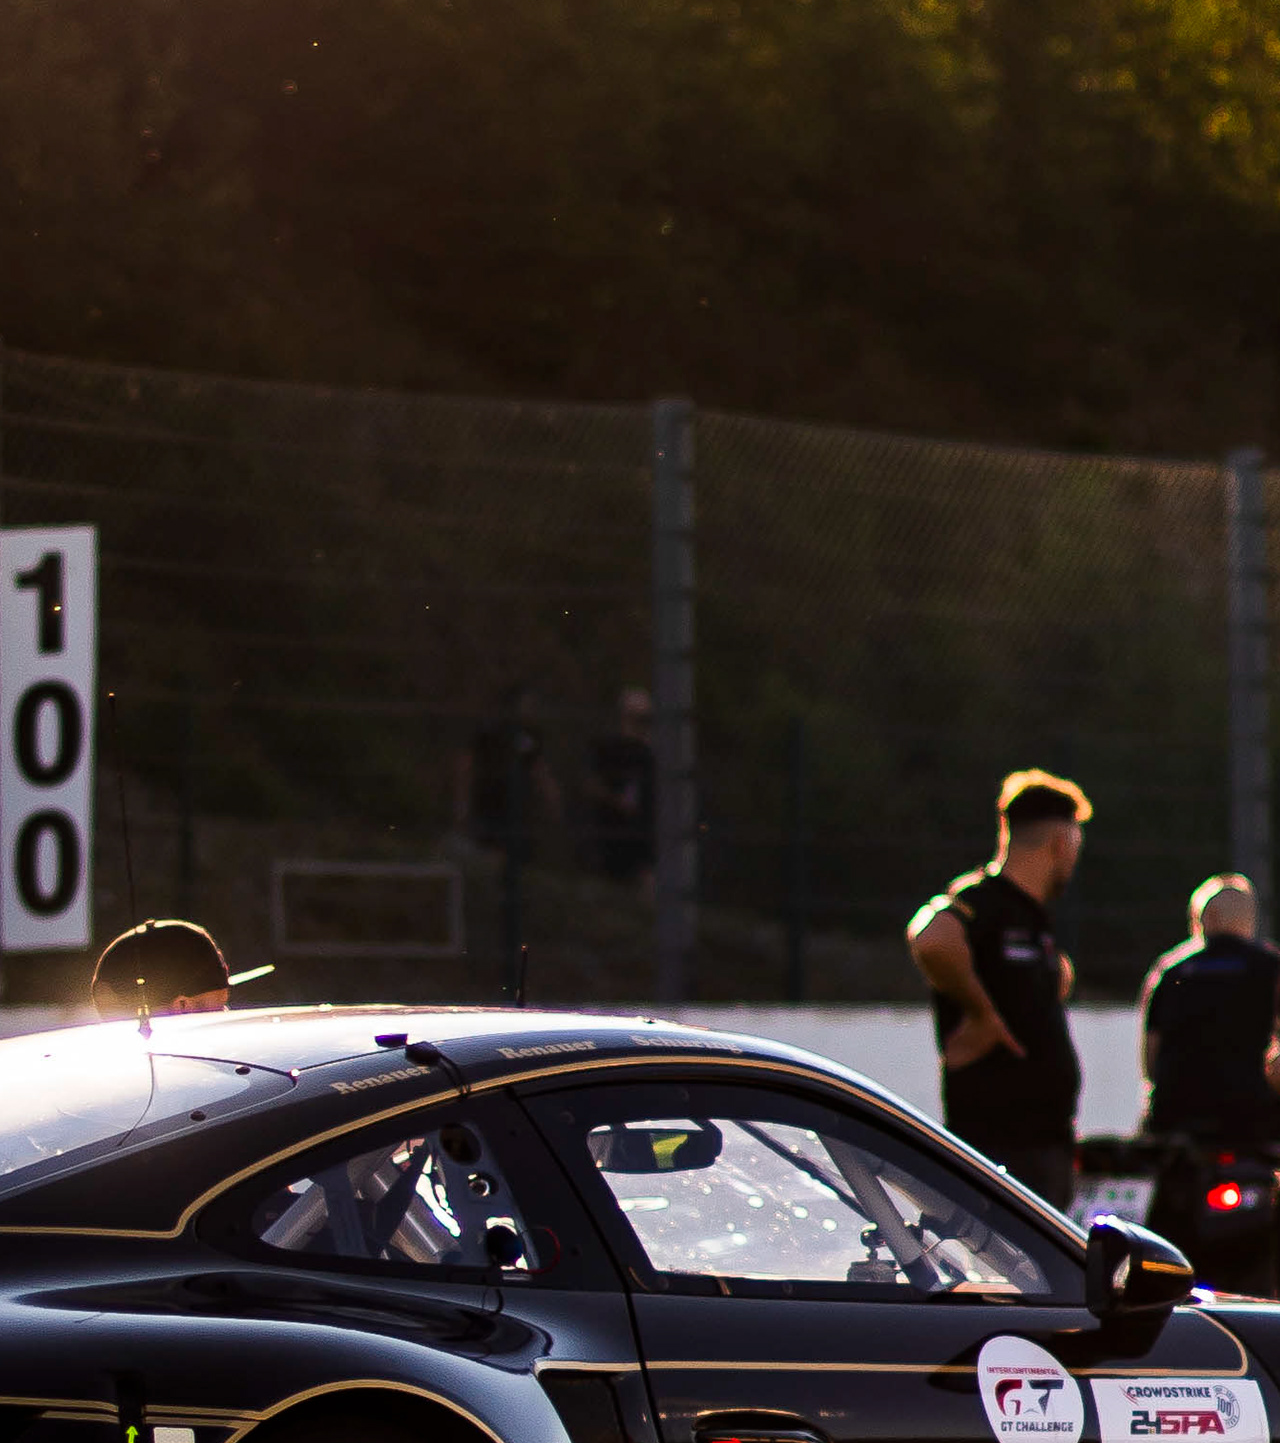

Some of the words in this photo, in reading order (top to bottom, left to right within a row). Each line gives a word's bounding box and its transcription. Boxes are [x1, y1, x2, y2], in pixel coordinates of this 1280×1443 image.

[15, 553, 81, 917] 100
[495, 1040, 597, 1059] Renauer
[329, 1064, 431, 1095] Renauer
[986, 1365, 1061, 1376] INTERCONTINENTAL
[1126, 1386, 1211, 1398] CROWDSTRIKE
[1001, 1421, 1013, 1432] GT
[1015, 1421, 1074, 1432] CHALLENGE
